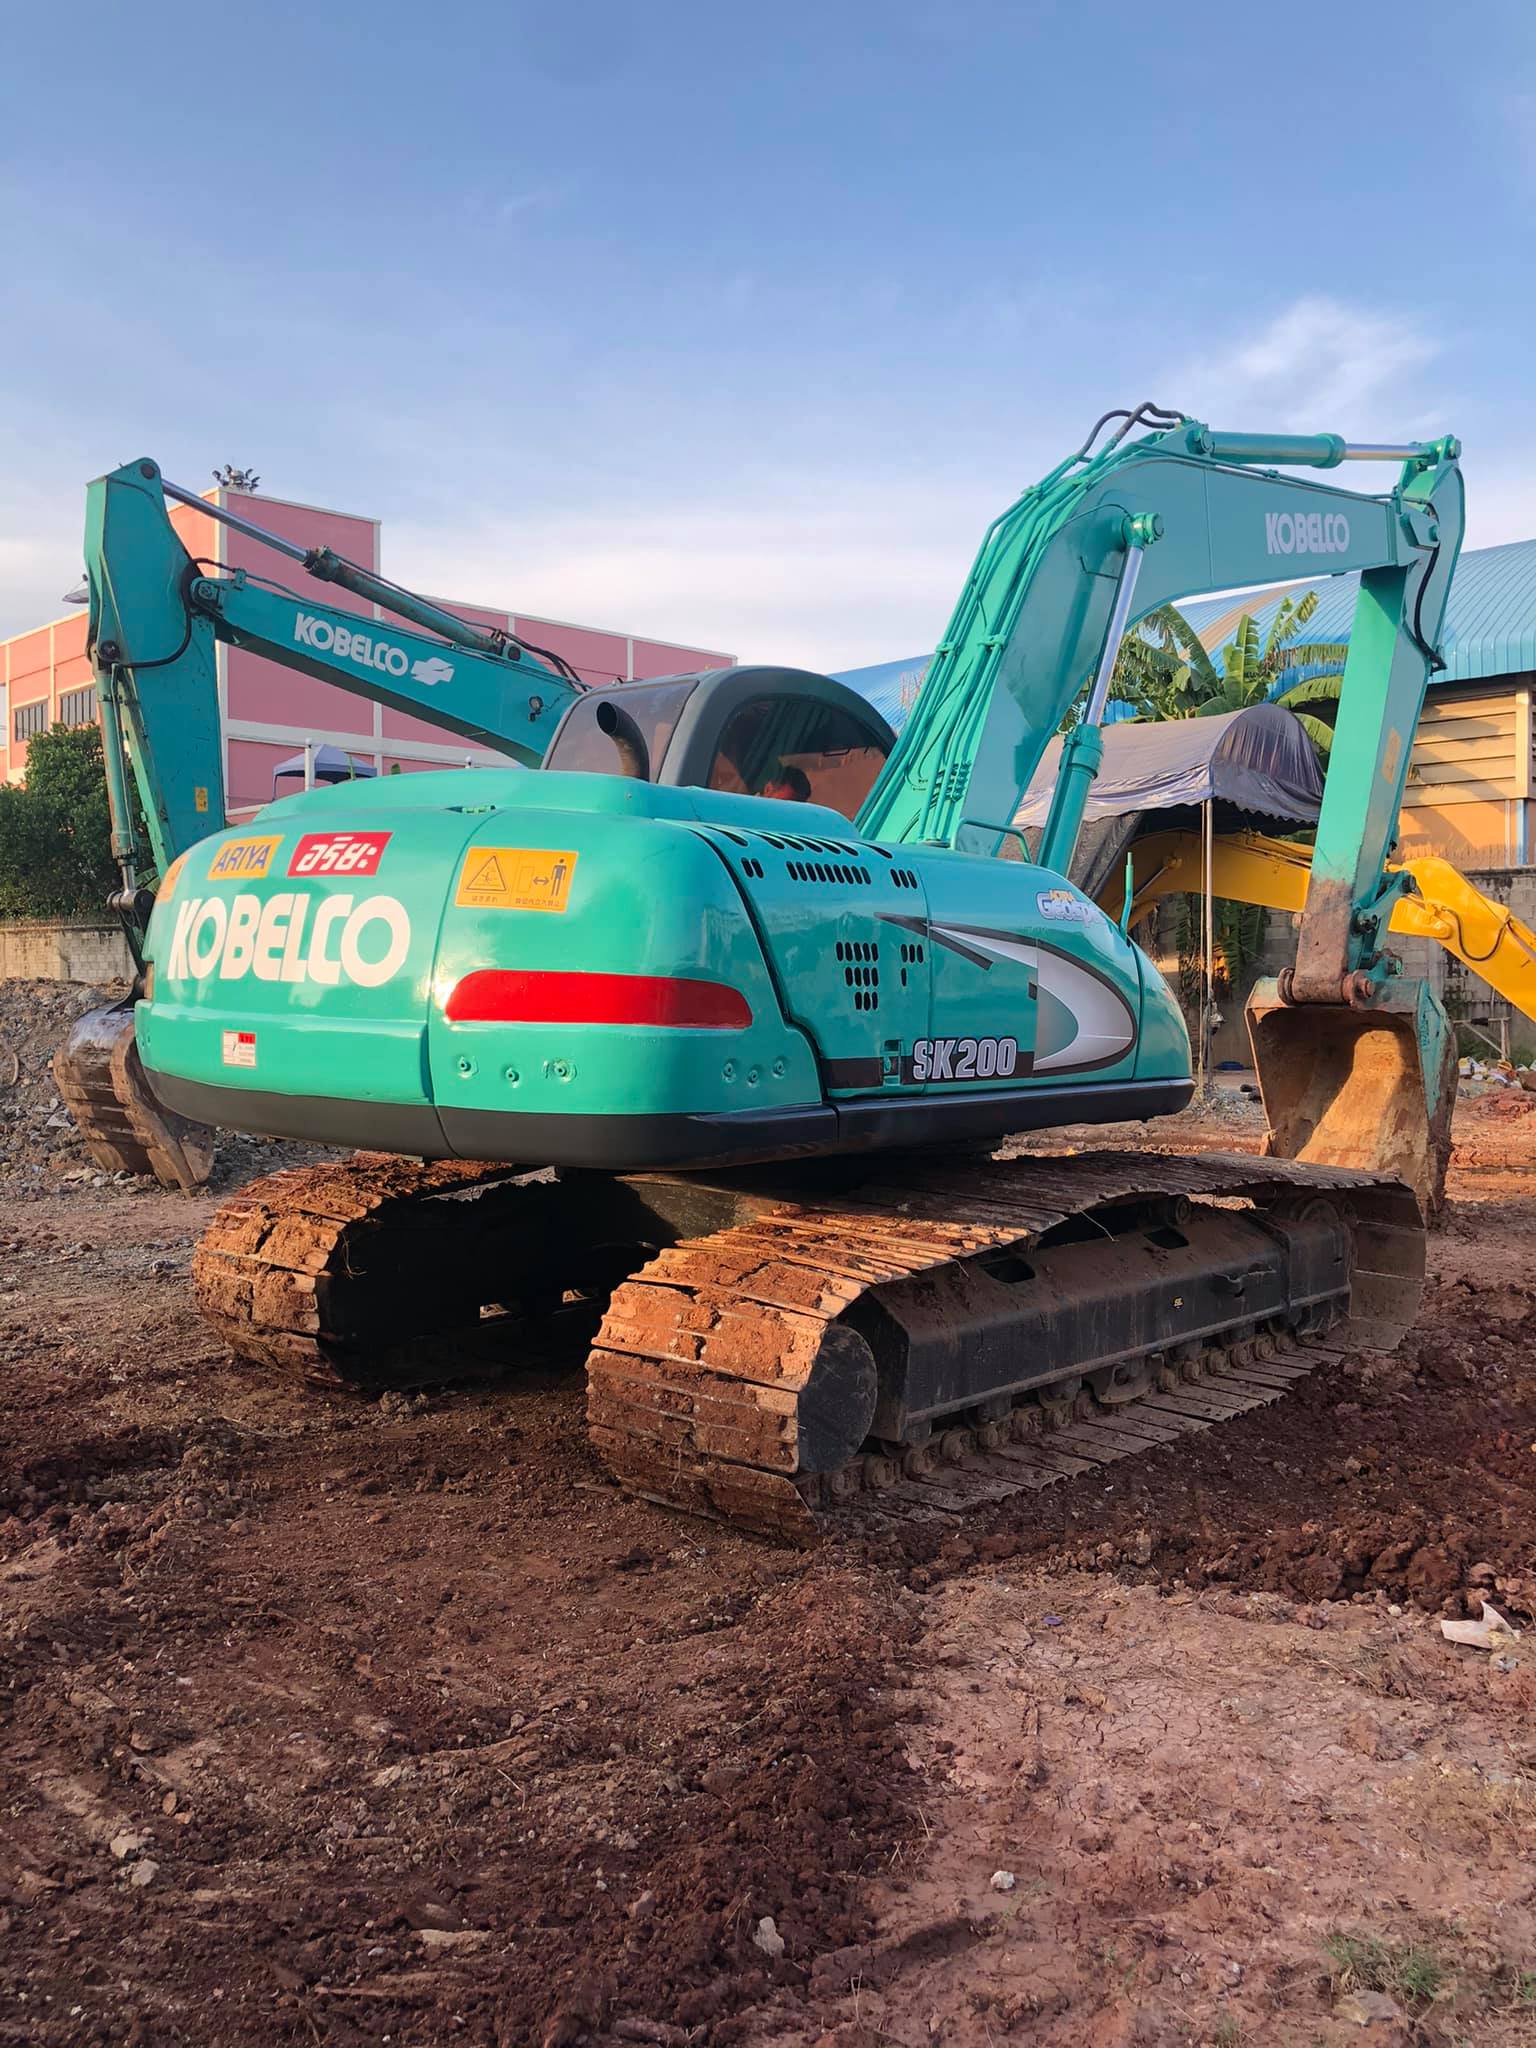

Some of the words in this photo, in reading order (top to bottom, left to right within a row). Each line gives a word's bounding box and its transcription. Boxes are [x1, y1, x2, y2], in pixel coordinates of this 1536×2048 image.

[1265, 512, 1350, 555] KOBELCO
[294, 612, 409, 677] KOBELCO
[212, 844, 272, 873] ARIYA
[167, 893, 411, 988] KOBELCO
[912, 1038, 1018, 1080] SK200
